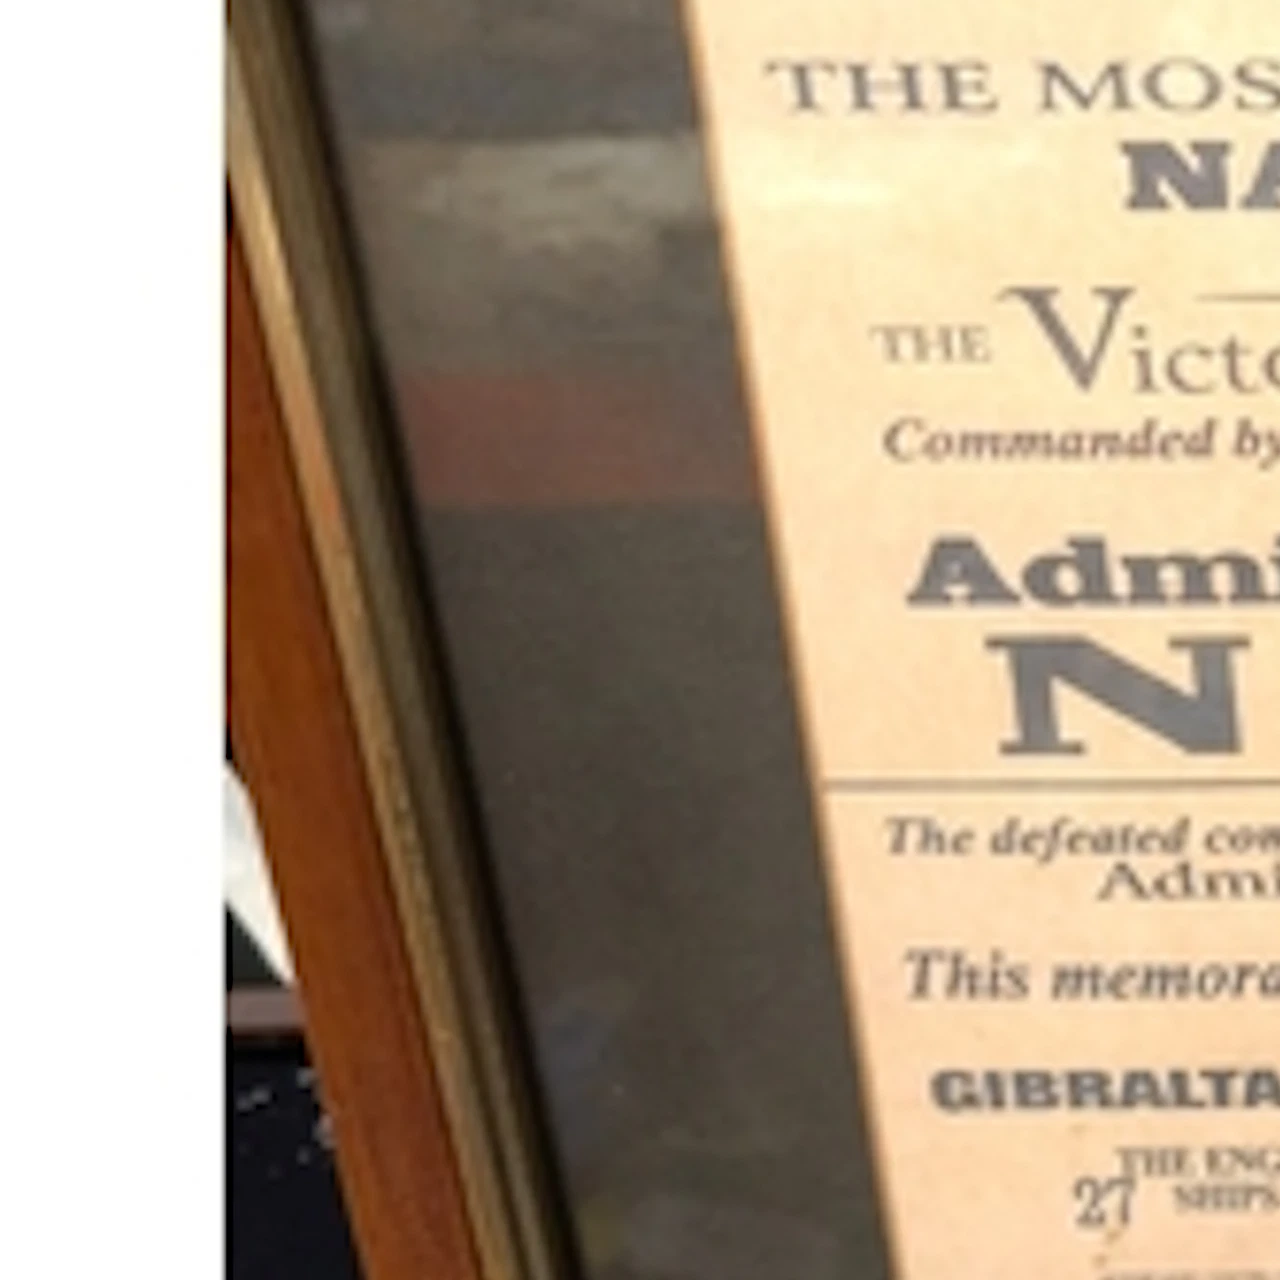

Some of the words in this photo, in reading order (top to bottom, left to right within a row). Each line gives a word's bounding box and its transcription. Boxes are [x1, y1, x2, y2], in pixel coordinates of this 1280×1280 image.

[766, 55, 1000, 113] THE
[867, 322, 993, 366] THE
[880, 415, 1216, 462] Commanded
[884, 814, 978, 856] The
[990, 814, 1192, 864] defeated
[903, 947, 1029, 1002] This
[1071, 1176, 1137, 1228] 27
[1173, 1183, 1279, 1214] SHIPS
